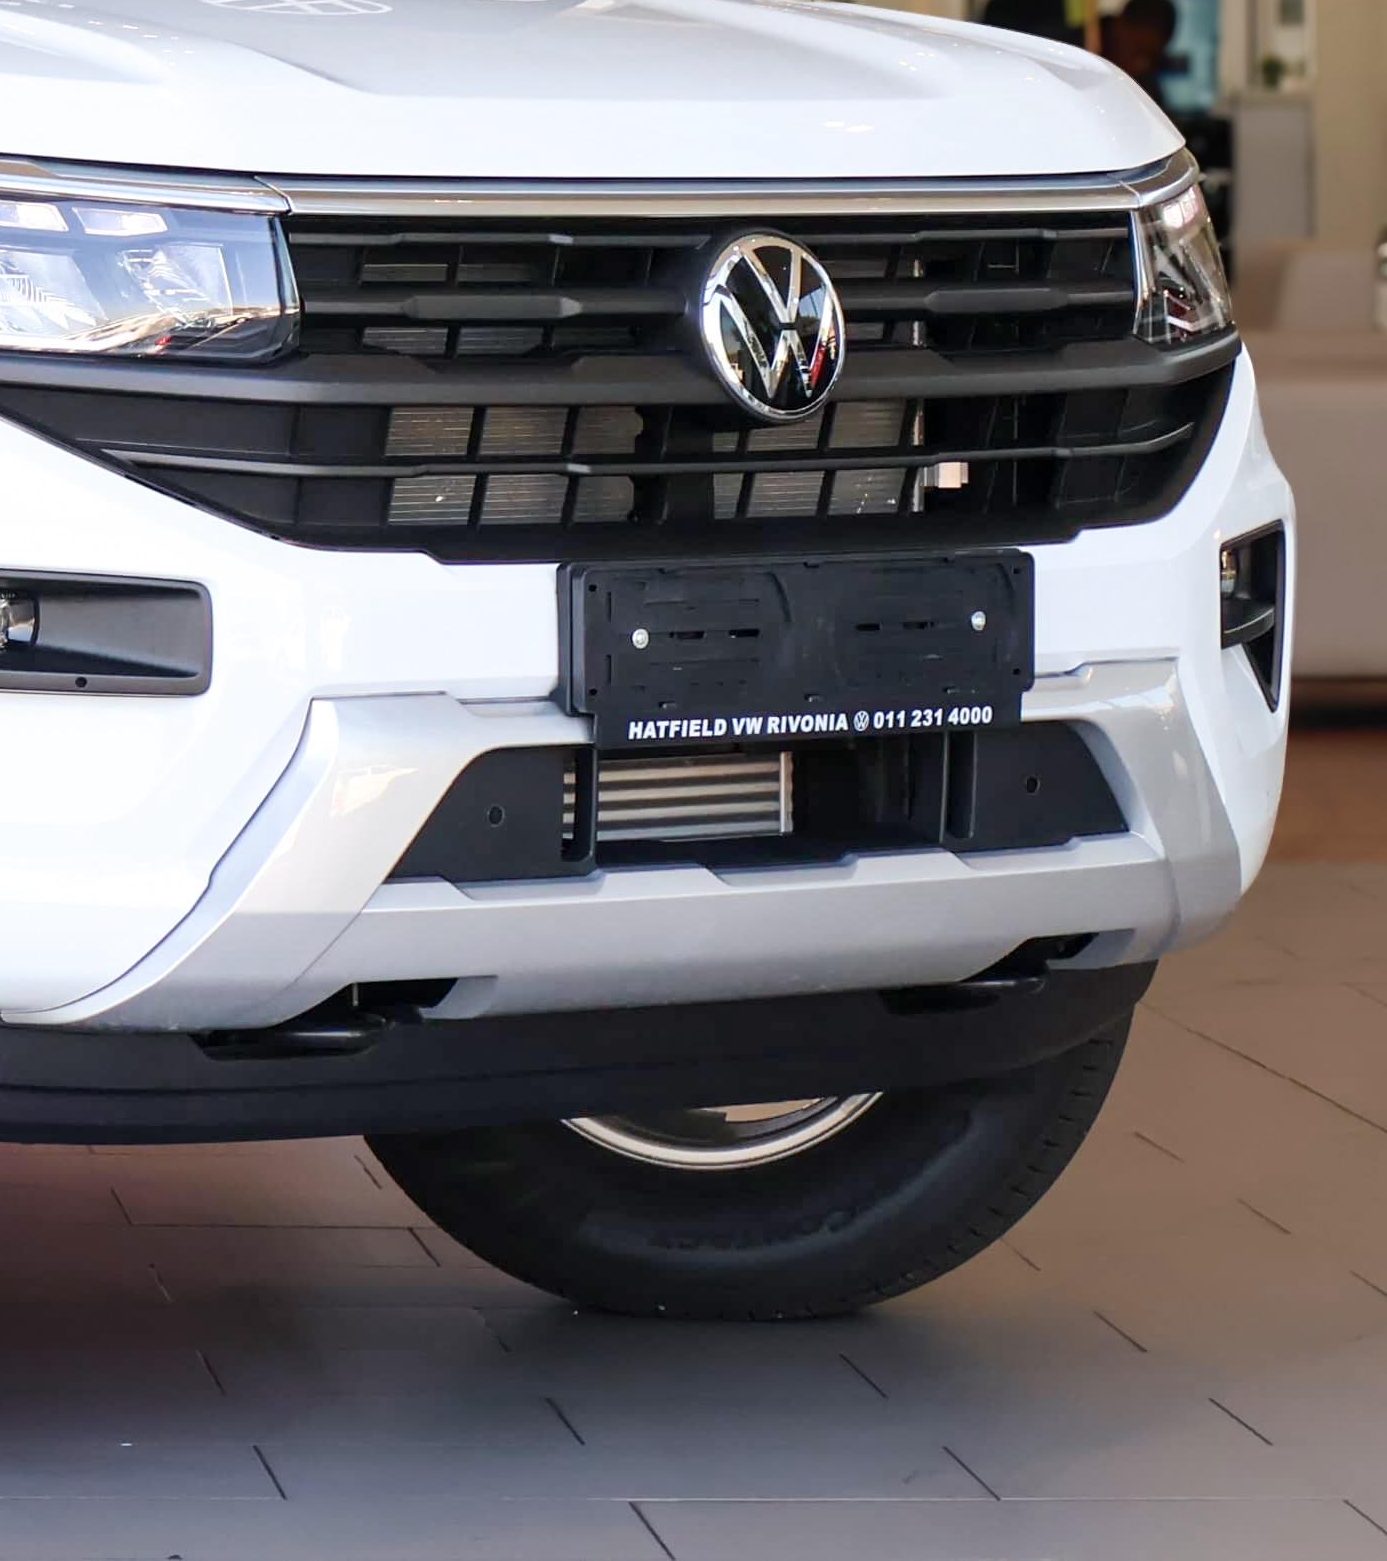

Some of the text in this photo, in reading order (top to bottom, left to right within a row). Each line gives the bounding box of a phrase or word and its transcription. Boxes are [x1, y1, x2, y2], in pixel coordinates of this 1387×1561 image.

[628, 718, 728, 740] HATFIELD
[731, 716, 764, 736] VW
[766, 713, 849, 734] RIVONIA
[873, 709, 906, 729] 011
[910, 708, 943, 728] 231
[947, 705, 993, 725] 4000
